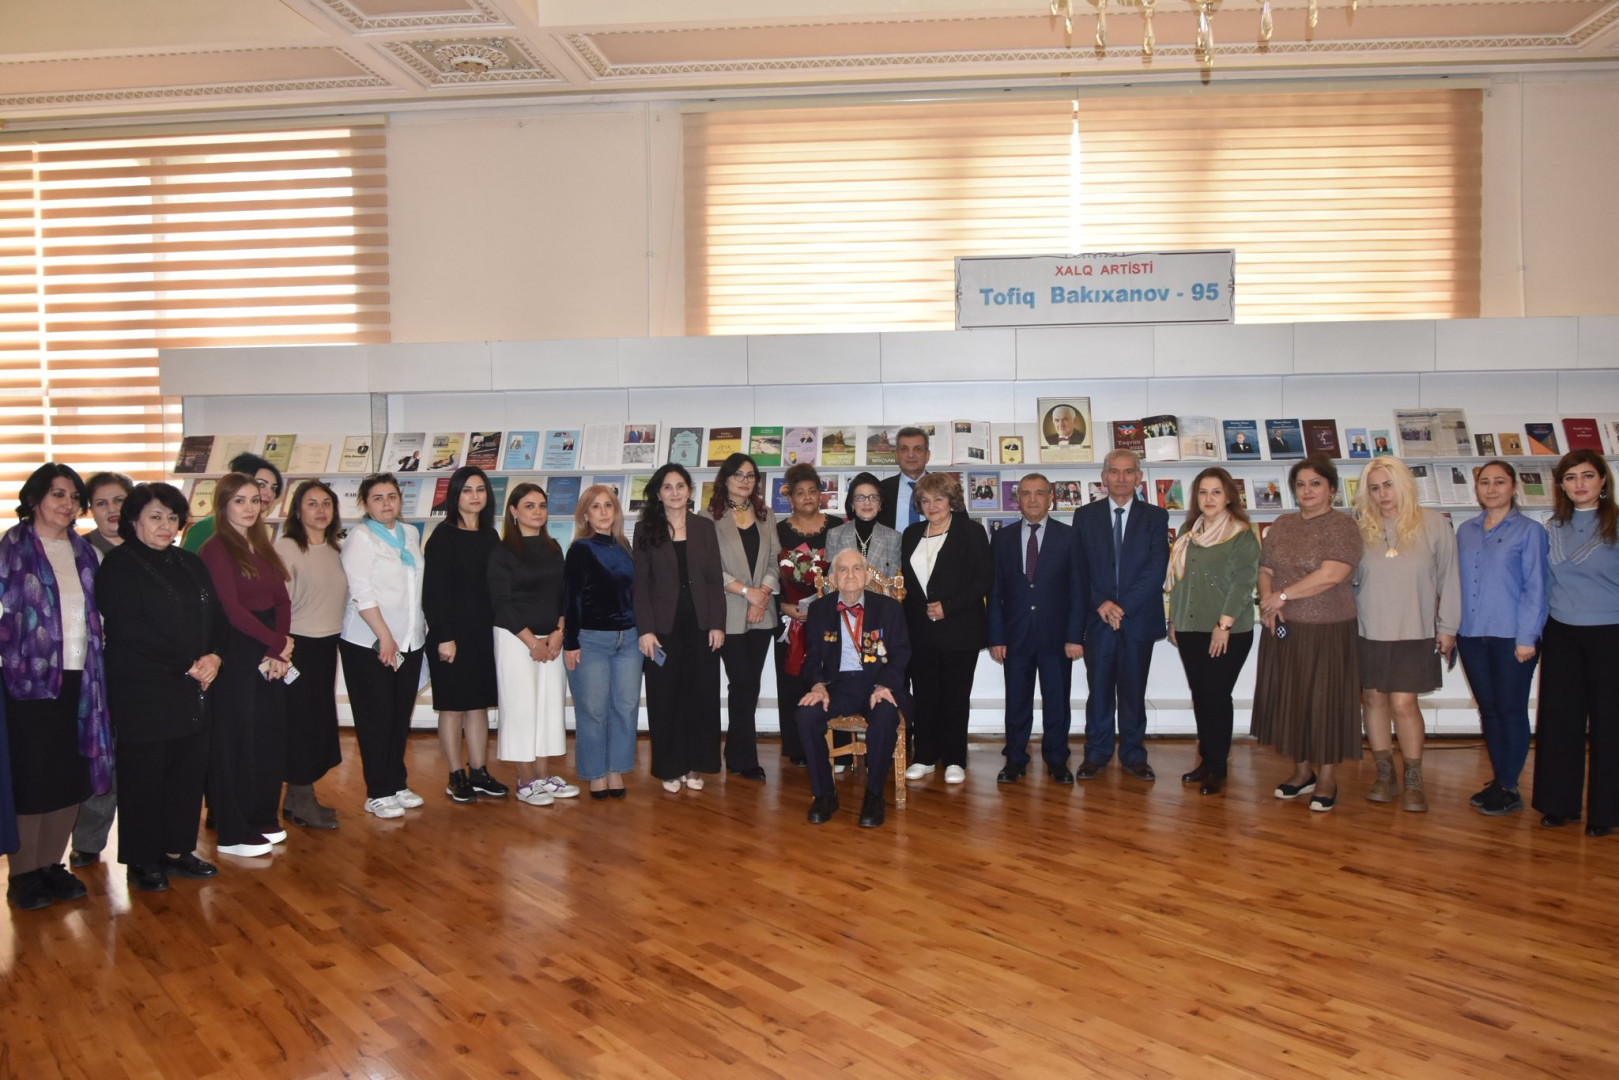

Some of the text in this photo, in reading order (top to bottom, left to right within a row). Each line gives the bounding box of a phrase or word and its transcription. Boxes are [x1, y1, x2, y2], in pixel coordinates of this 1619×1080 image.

[1055, 261, 1153, 277] XALQ ARTİSTİ
[979, 287, 1035, 309] Tofiq
[1051, 285, 1170, 304] Bakıxanov
[1191, 282, 1219, 301] 95
